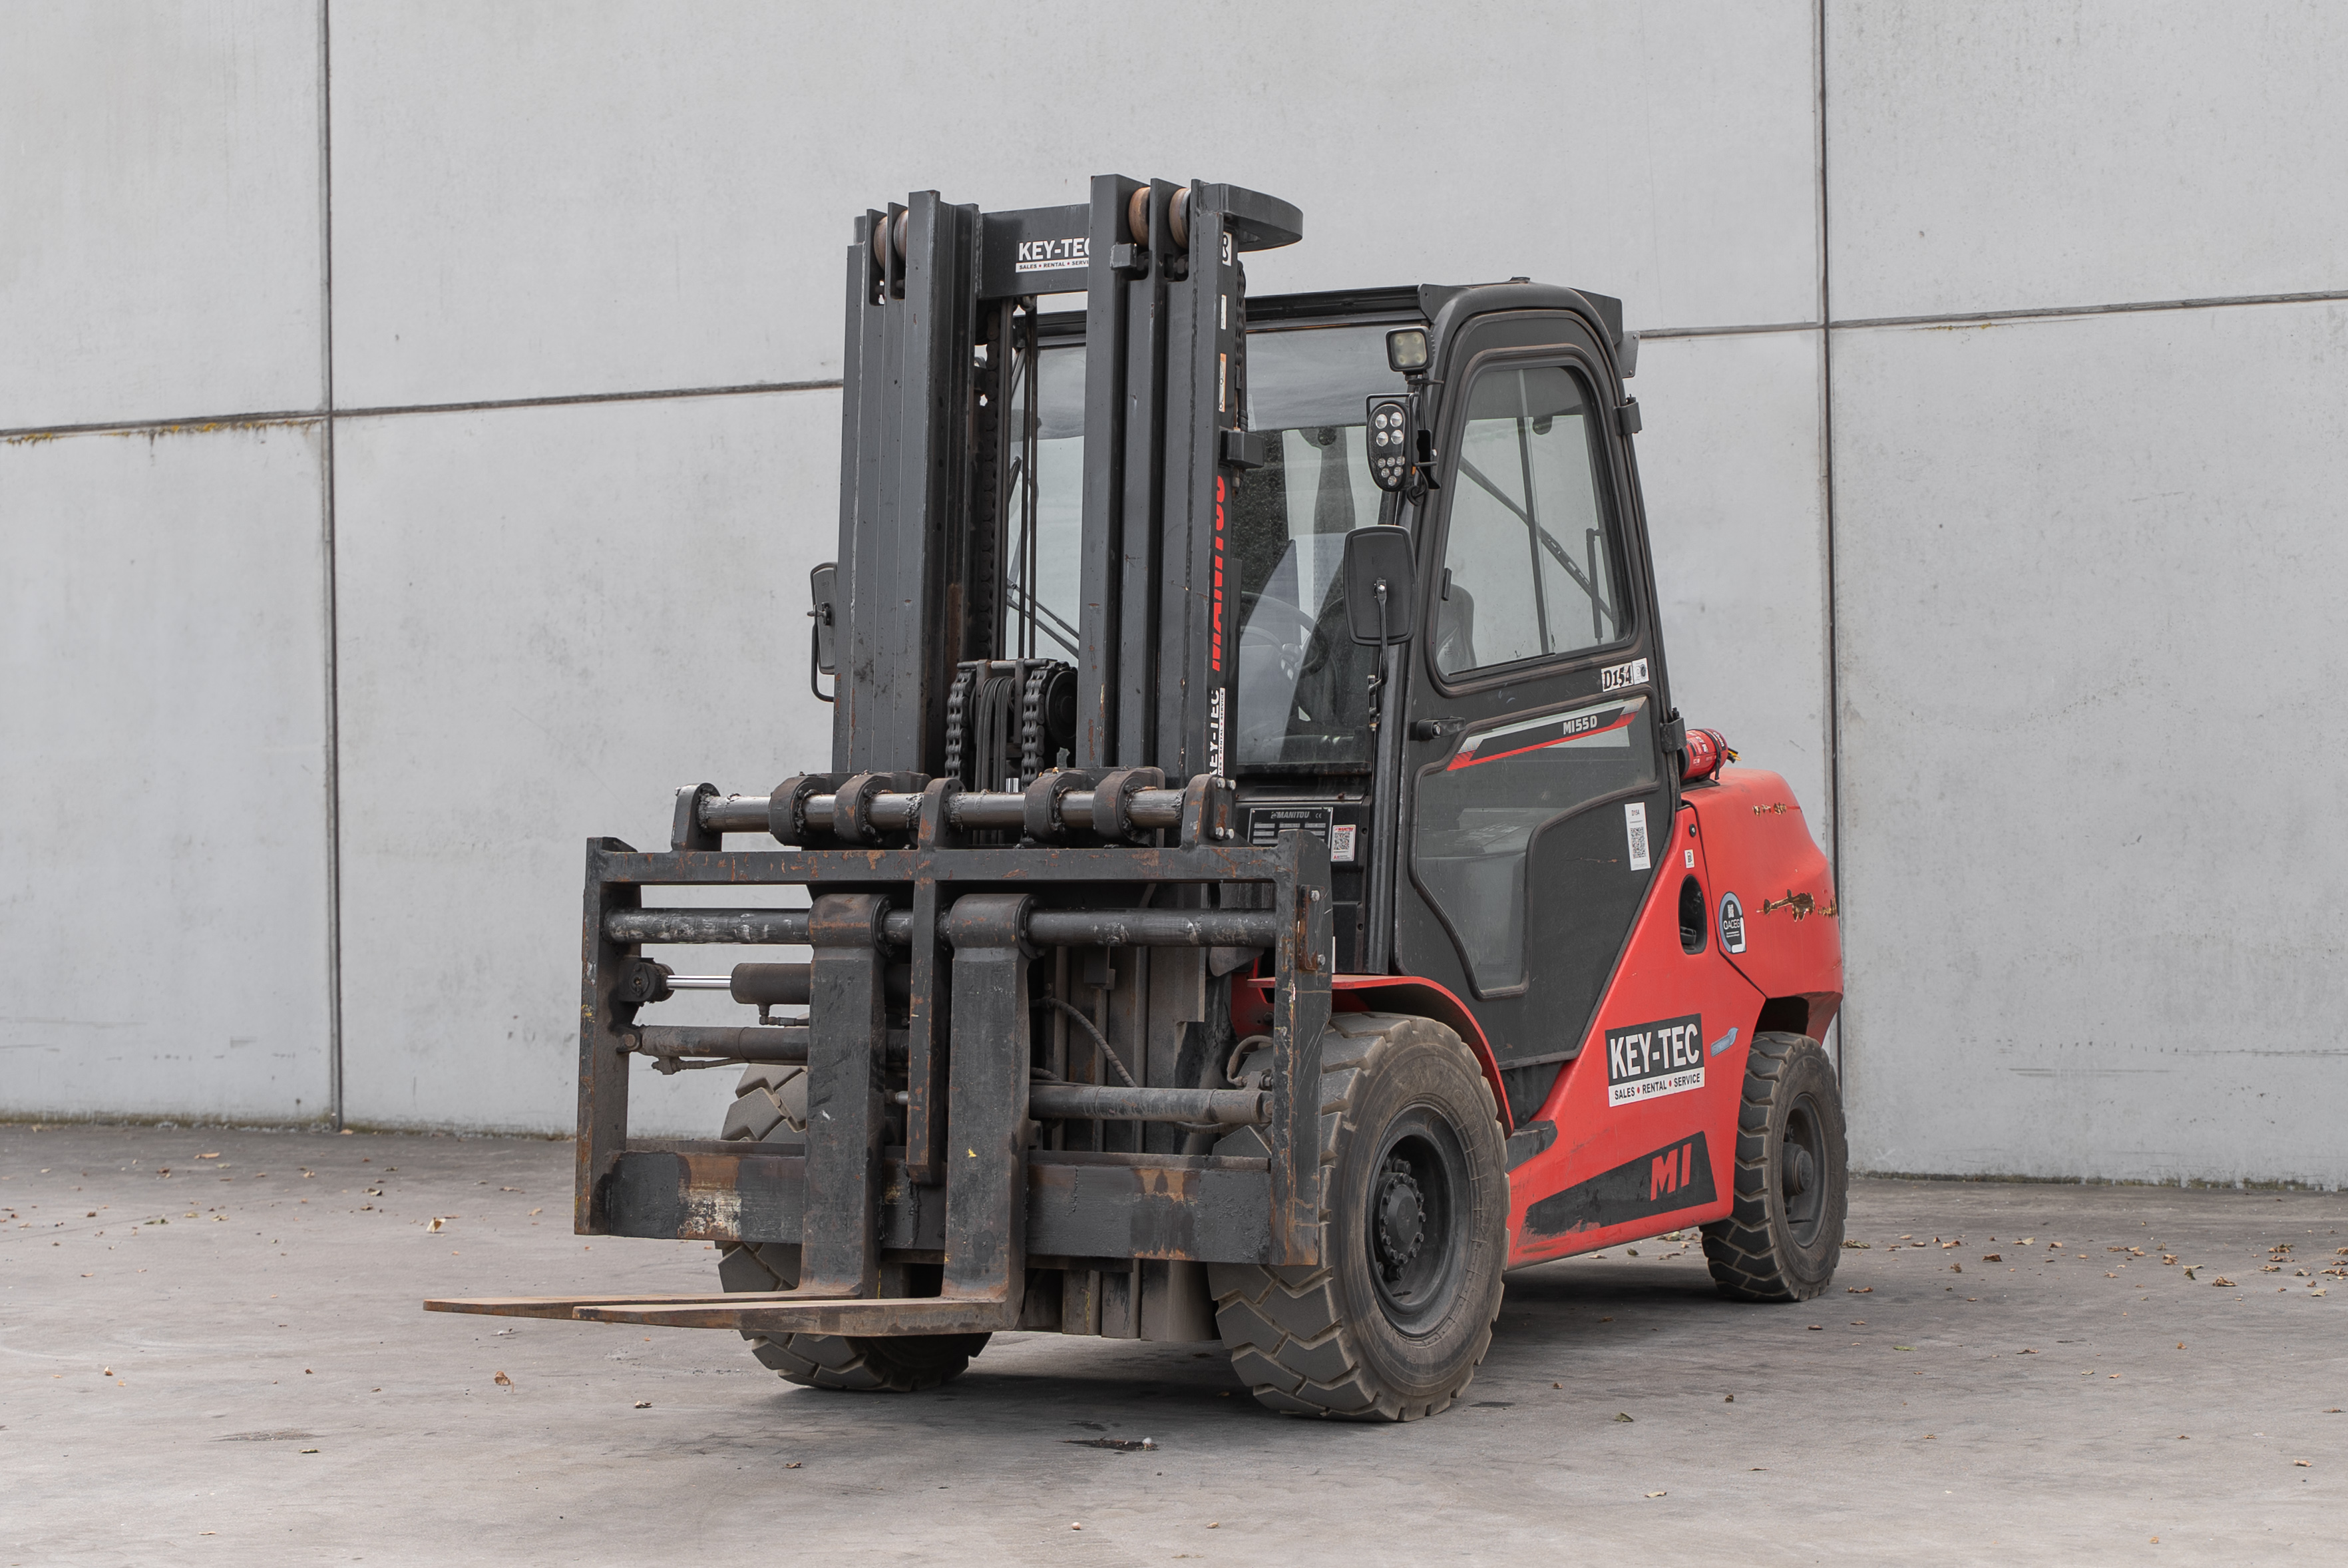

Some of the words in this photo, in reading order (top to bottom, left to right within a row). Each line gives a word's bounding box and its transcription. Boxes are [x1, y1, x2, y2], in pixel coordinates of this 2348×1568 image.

[1603, 666, 1633, 689] D154
[1610, 1023, 1700, 1079] KEY-TEC
[1615, 1086, 1635, 1100] SALES
[1642, 1079, 1667, 1095] RENTAL
[1674, 1073, 1700, 1087] SERVICE
[1651, 1142, 1692, 1201] MI
